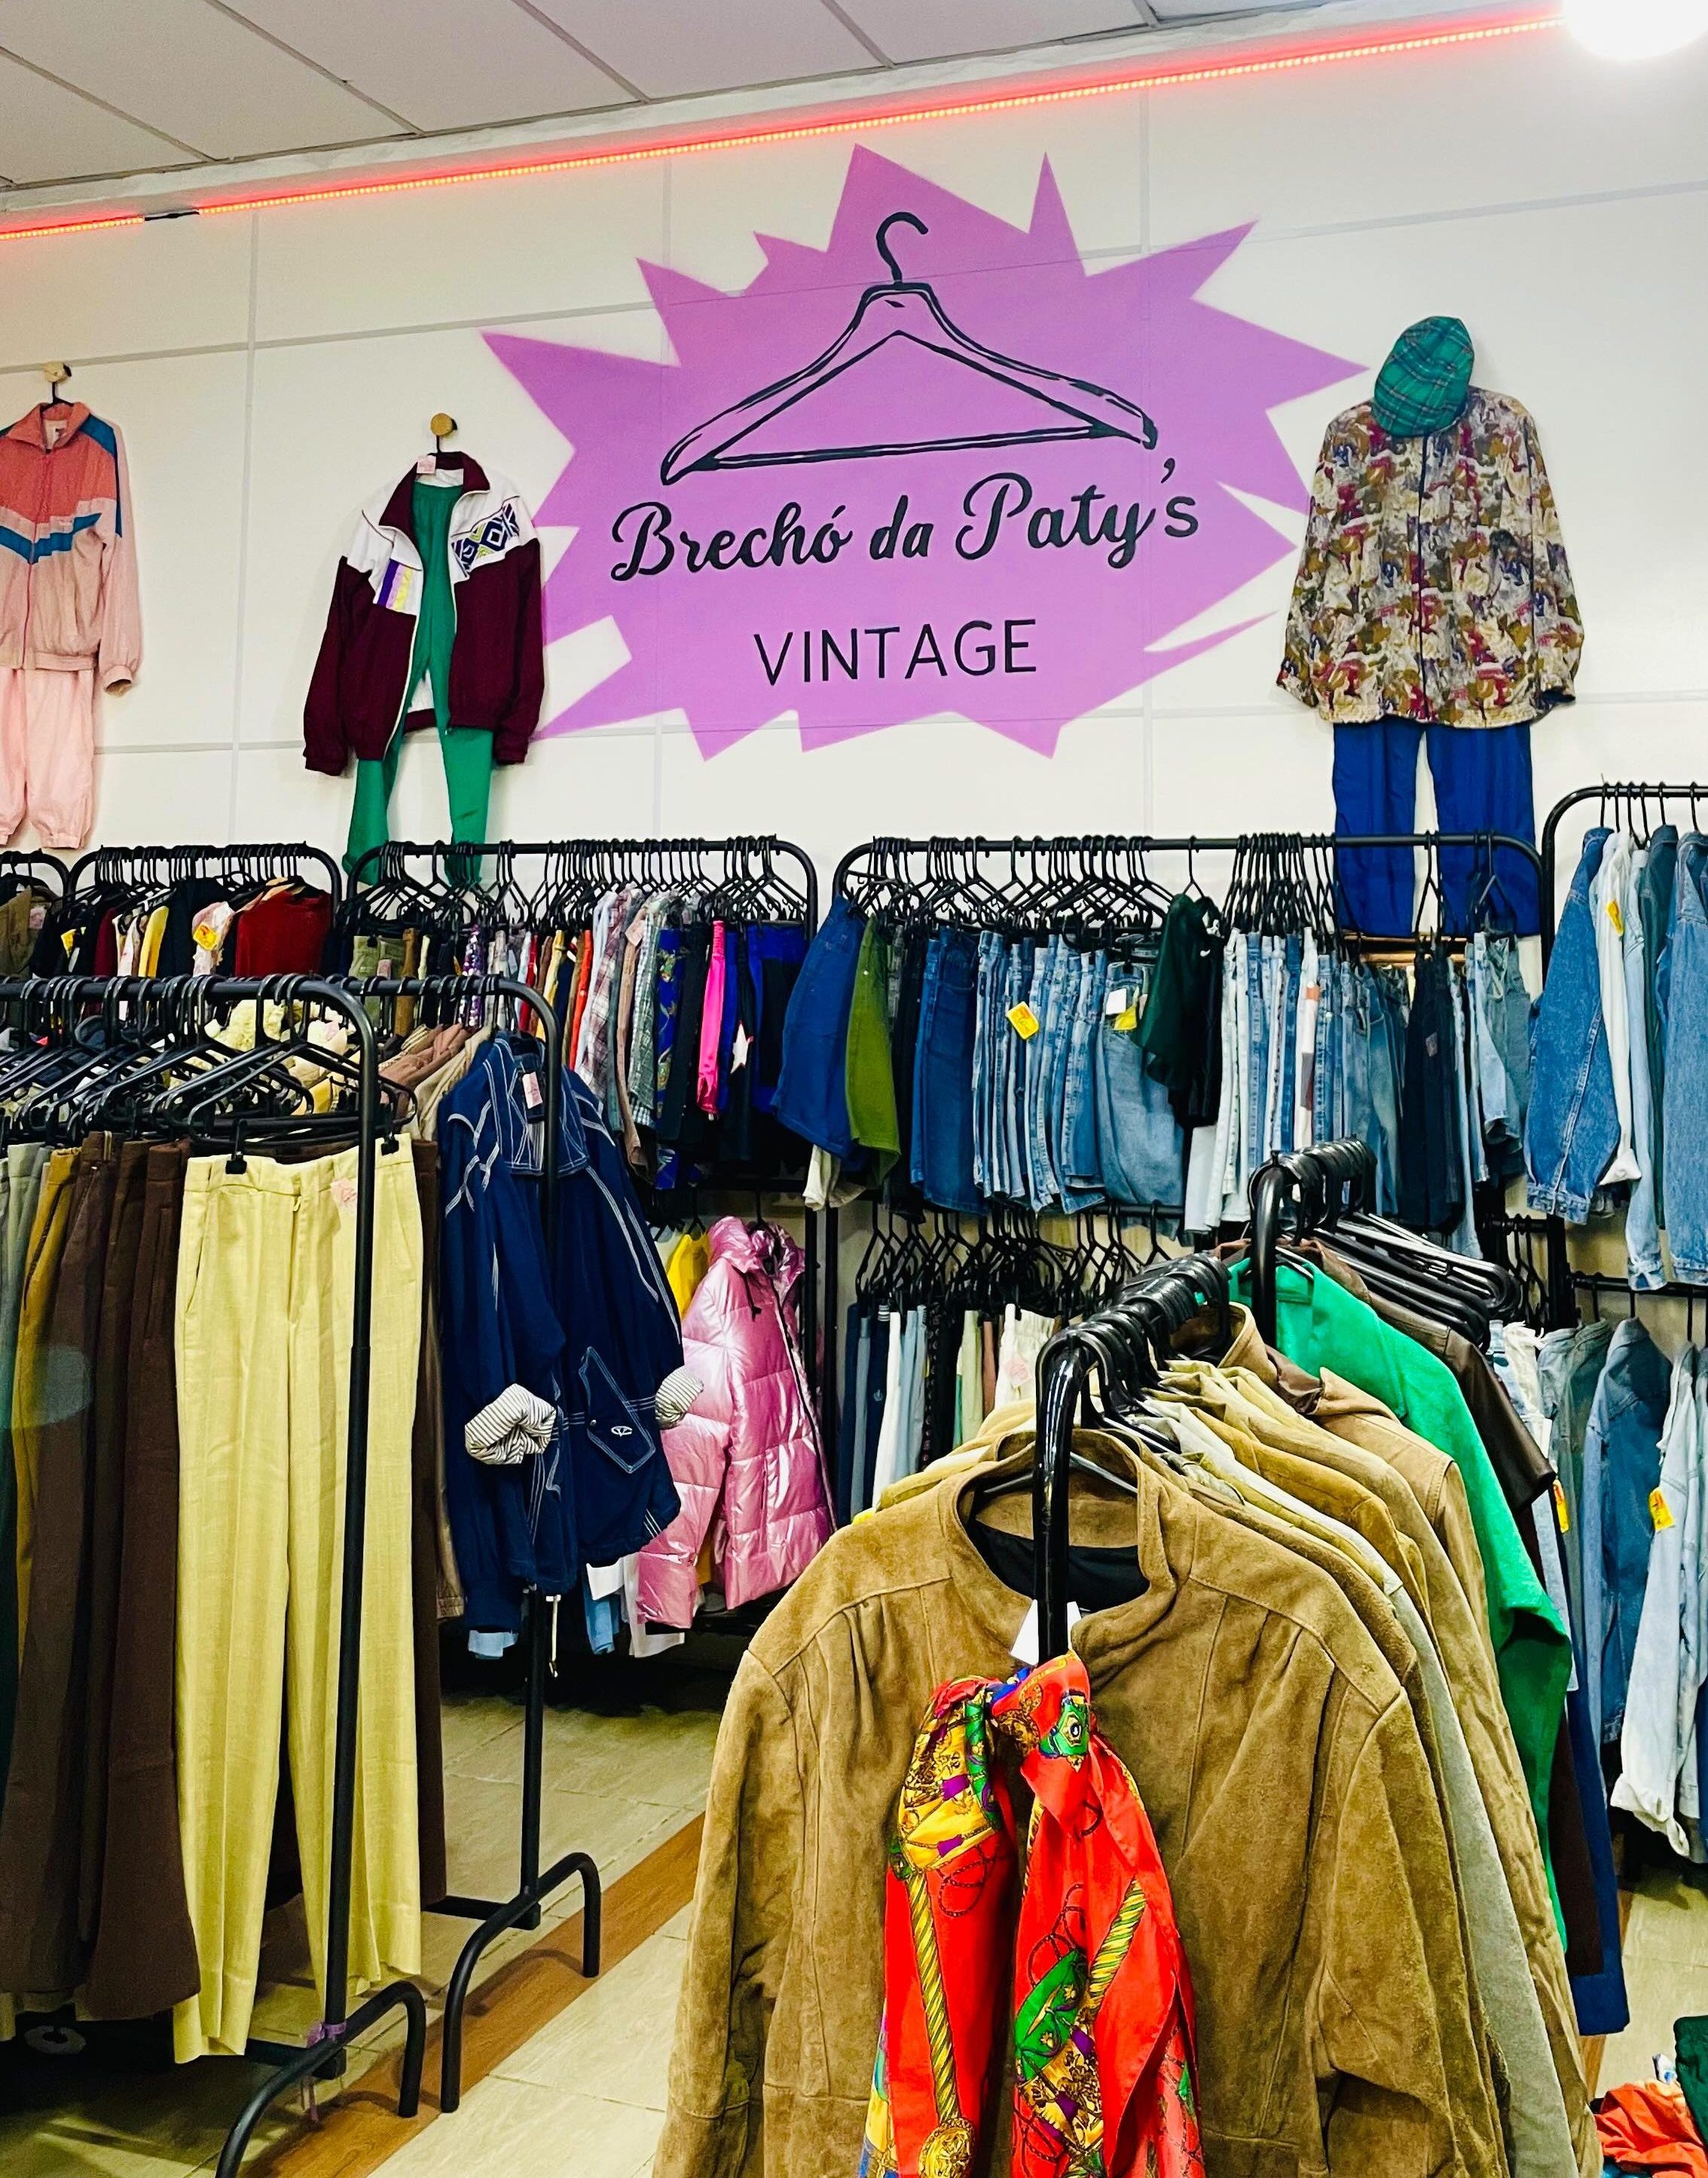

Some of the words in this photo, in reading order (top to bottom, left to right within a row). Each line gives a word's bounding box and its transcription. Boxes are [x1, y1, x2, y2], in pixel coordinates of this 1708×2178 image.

[610, 500, 854, 583] Brechó
[868, 494, 935, 561] da
[955, 457, 1199, 570] Paty's
[753, 618, 1037, 687] VINTAGE
